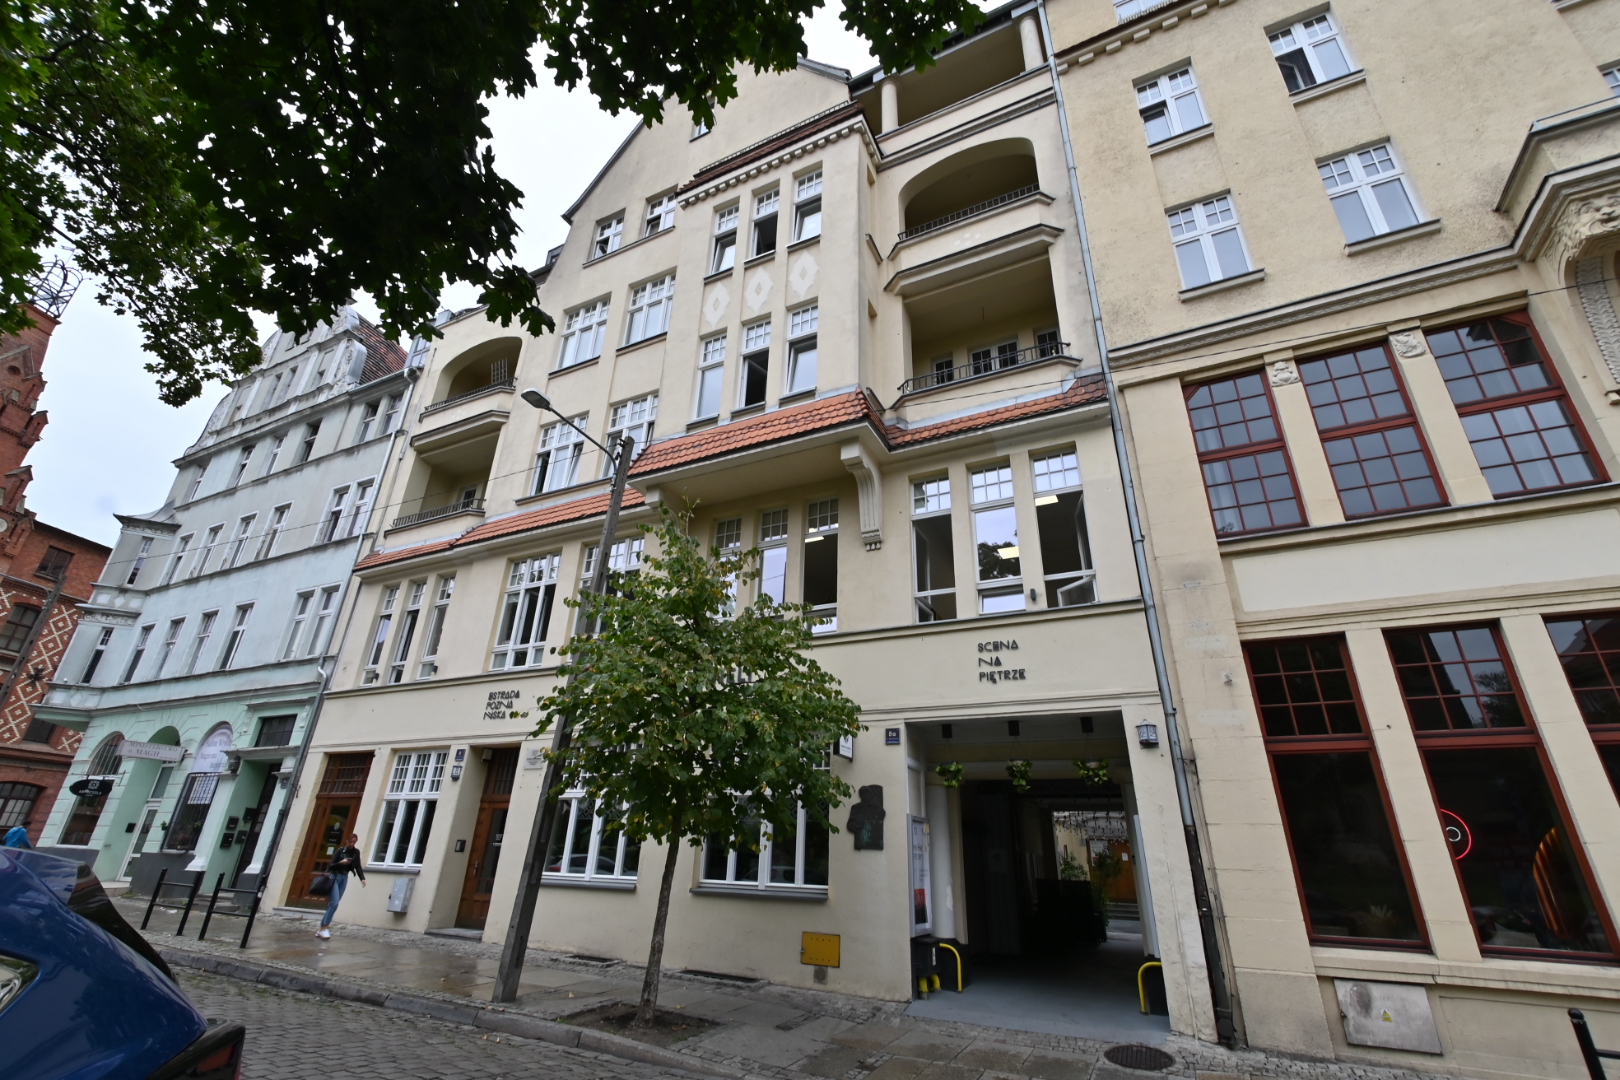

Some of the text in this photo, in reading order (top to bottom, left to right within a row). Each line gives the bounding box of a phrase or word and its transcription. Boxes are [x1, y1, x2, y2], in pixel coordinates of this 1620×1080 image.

[977, 639, 1019, 653] SCENA
[978, 656, 1002, 667] NA
[979, 668, 1026, 684] PIĘTRZE
[488, 690, 520, 701] ESTRADA
[130, 741, 178, 752] MINISTERSTWO
